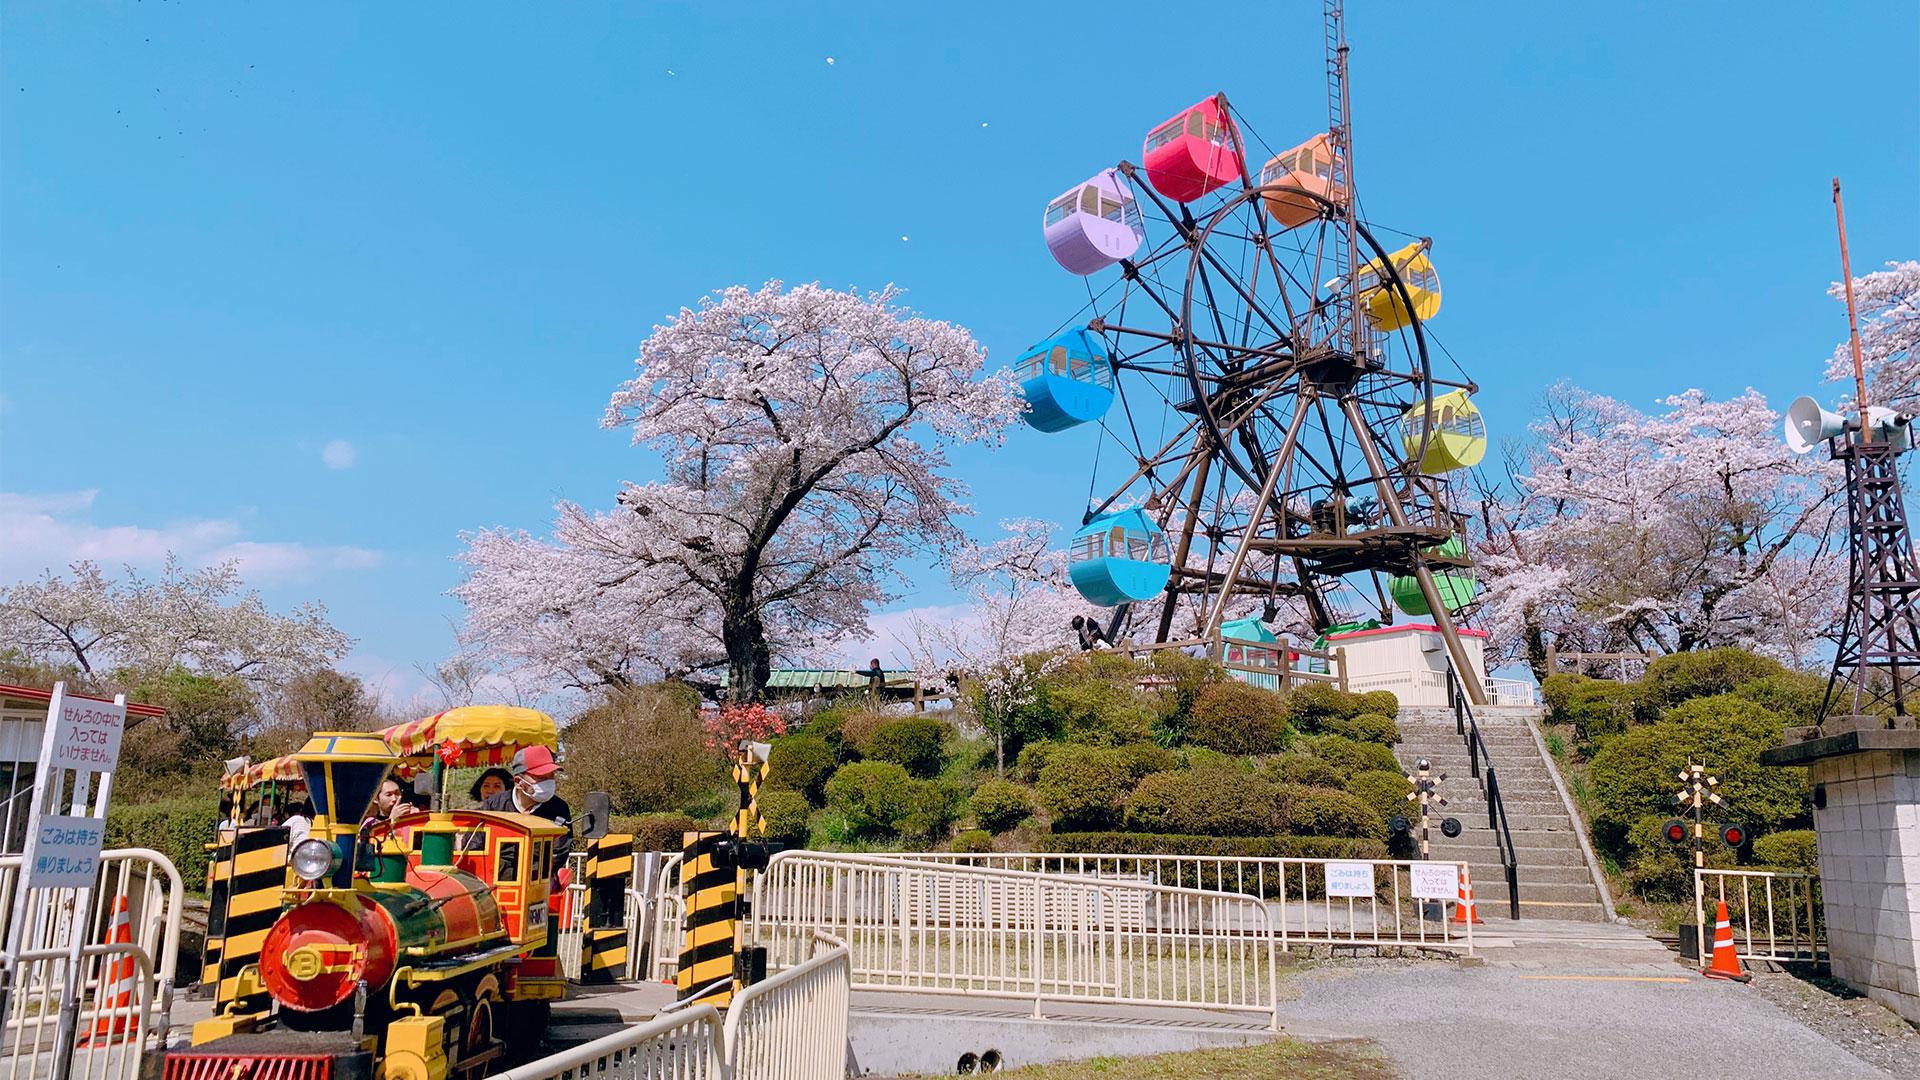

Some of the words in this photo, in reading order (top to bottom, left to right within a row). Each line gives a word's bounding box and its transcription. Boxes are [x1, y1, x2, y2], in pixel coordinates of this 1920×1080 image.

[64, 708, 120, 727] せんろの中に
[69, 727, 107, 744] 入っては
[59, 745, 111, 763] いけません。
[41, 828, 98, 846] ごみは持ち
